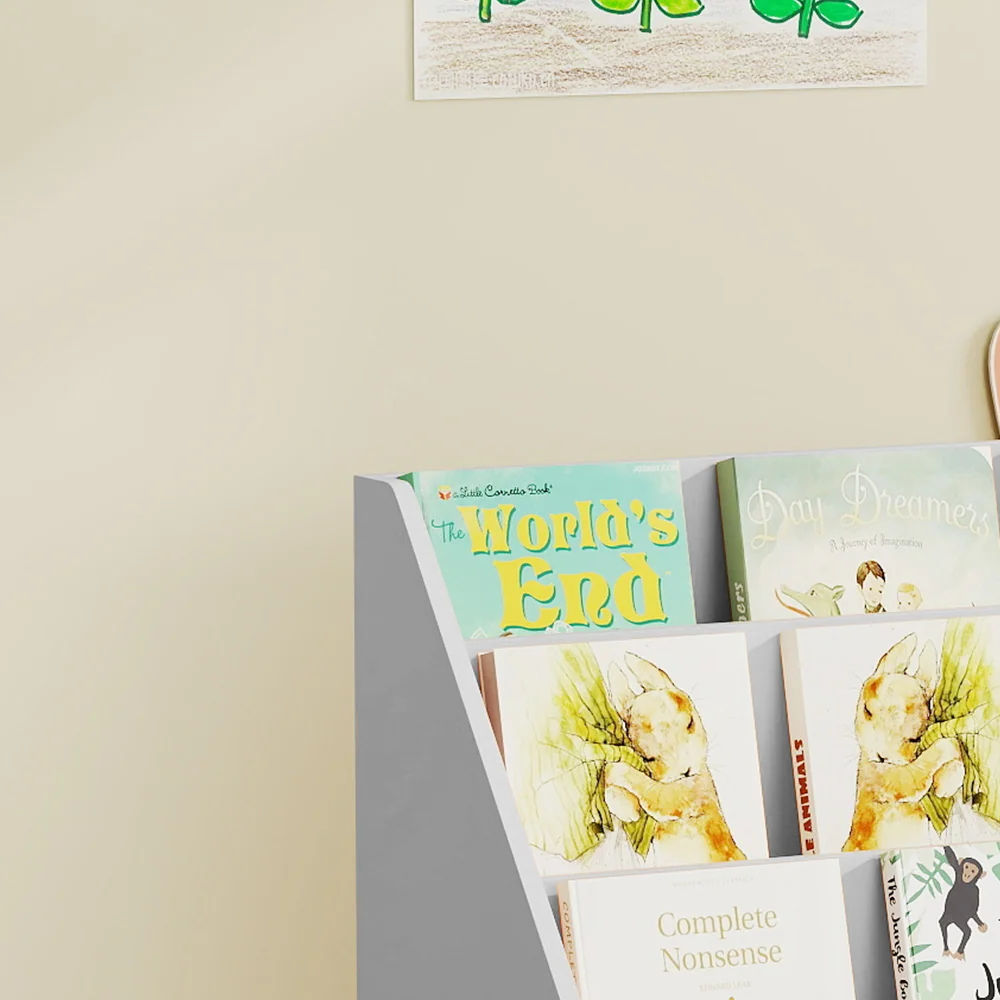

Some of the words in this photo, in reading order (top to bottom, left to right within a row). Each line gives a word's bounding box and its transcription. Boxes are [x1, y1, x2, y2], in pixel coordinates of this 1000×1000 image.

[430, 519, 465, 543] The
[457, 498, 680, 555] World's
[747, 479, 825, 549] Day
[841, 463, 990, 537] Dreamers
[493, 552, 669, 632] End
[794, 739, 813, 833] ANIMALS
[805, 838, 815, 854] E
[886, 875, 897, 906] The
[657, 905, 778, 939] Complete
[890, 912, 907, 975] Jungle
[660, 943, 783, 973] Nonsense
